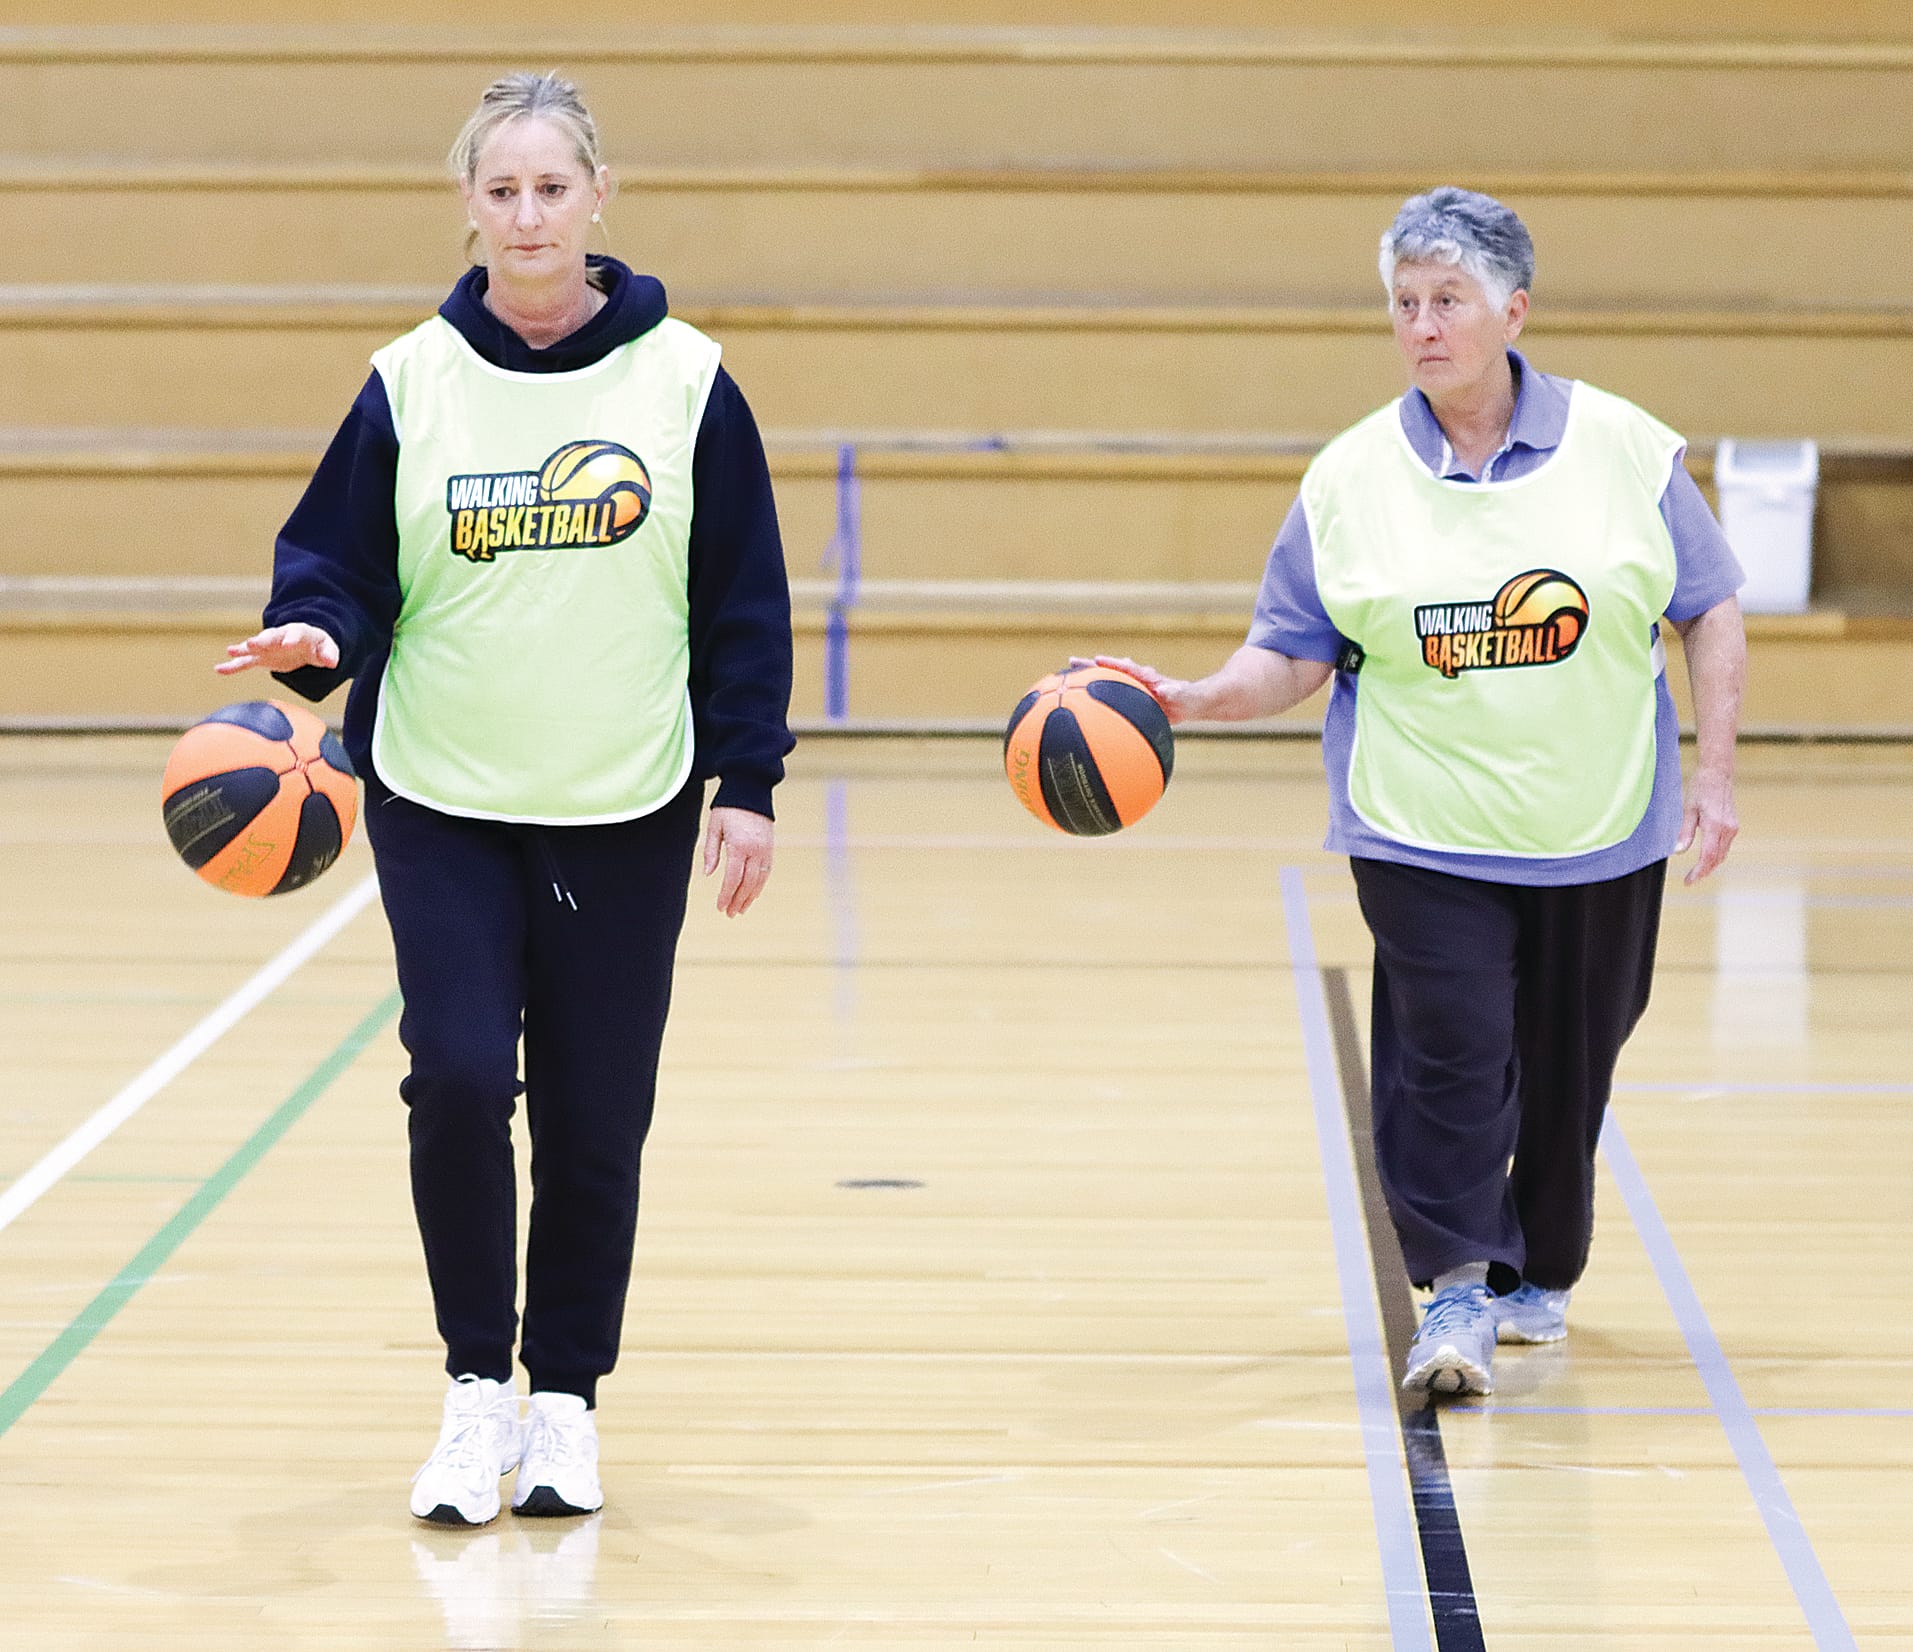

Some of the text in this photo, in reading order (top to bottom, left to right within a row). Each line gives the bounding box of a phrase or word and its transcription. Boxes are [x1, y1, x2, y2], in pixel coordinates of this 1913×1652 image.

[451, 475, 540, 510] WALKING
[455, 502, 613, 559] BASKETBALL
[1418, 604, 1494, 636] WALKING
[1424, 626, 1558, 676] BASKETBALL
